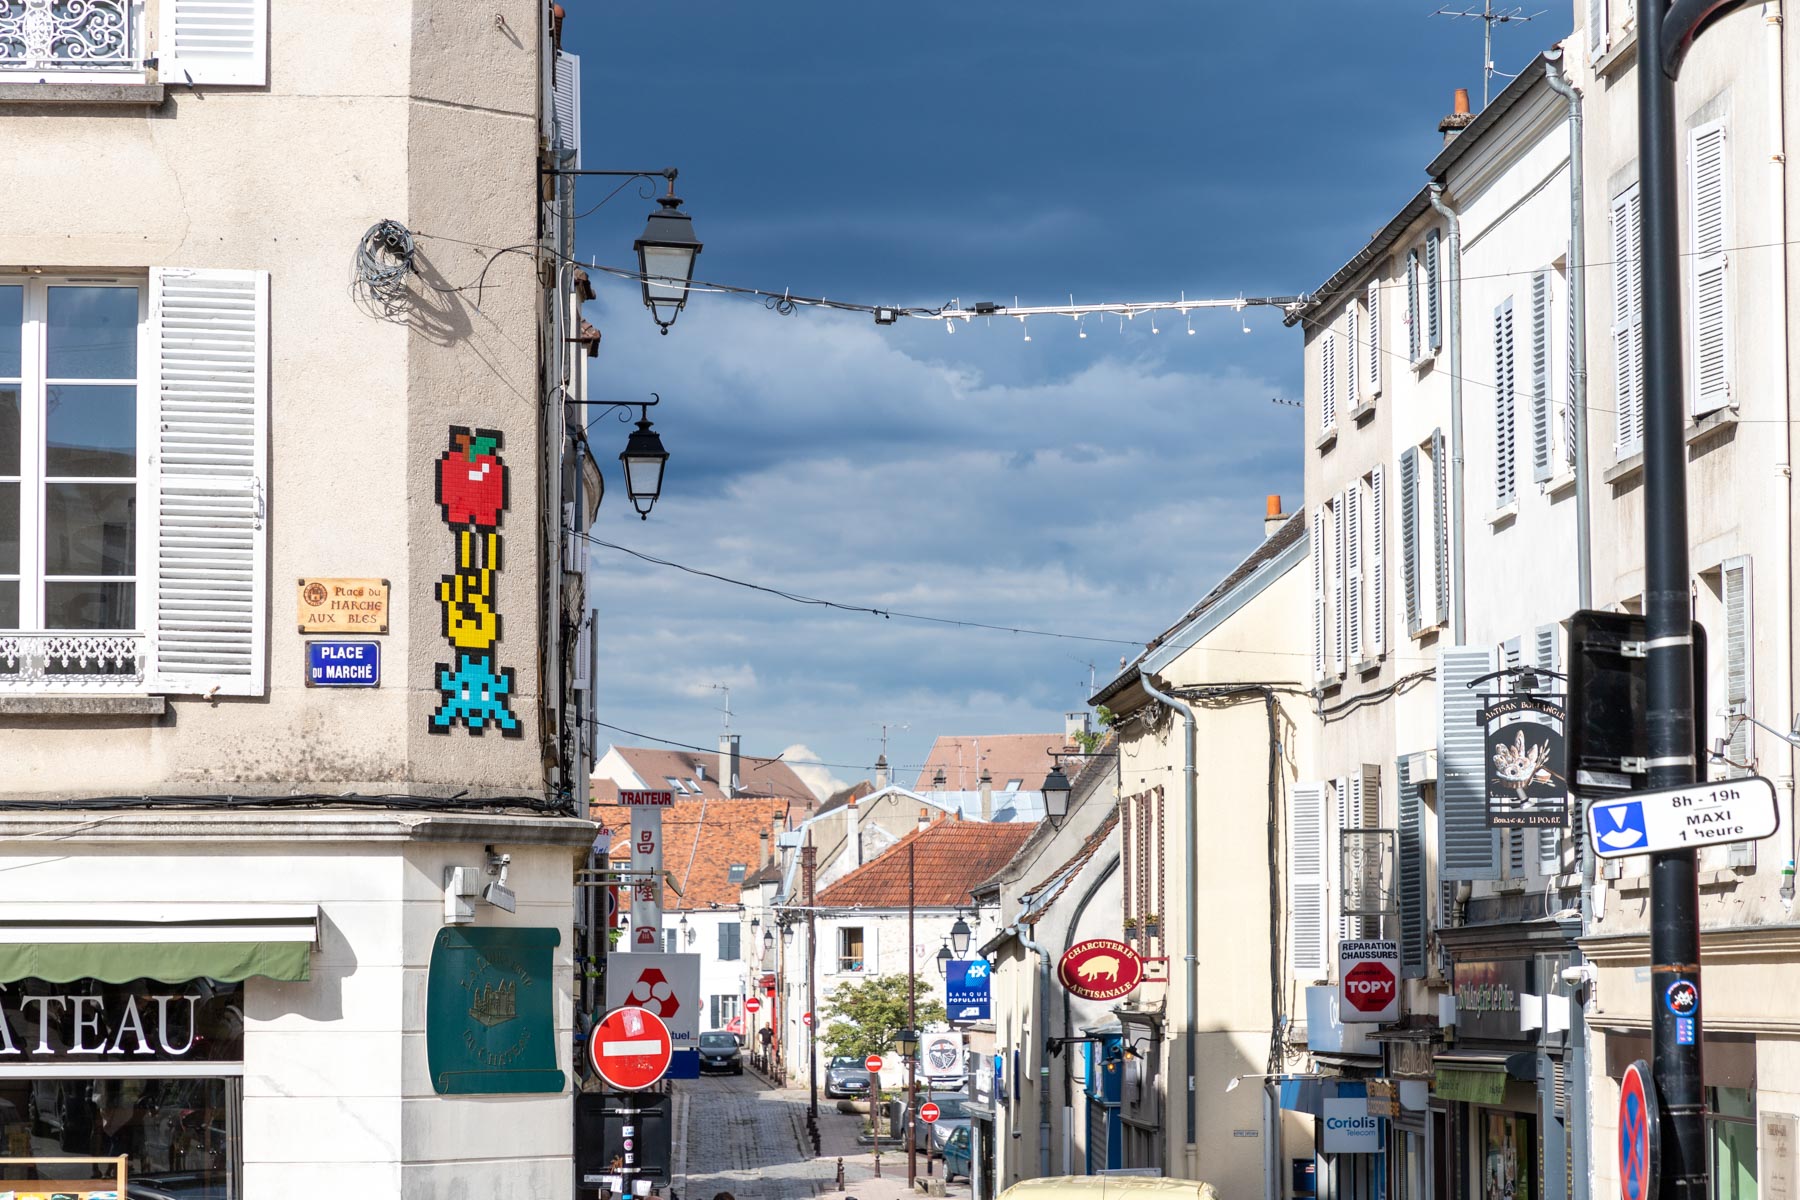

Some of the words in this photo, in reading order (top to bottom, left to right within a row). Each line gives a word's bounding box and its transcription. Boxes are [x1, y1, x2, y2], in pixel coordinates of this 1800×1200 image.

[335, 586, 364, 597] Place
[368, 588, 381, 597] du
[330, 600, 383, 611] MARCHE
[308, 613, 336, 623] AUX
[348, 614, 377, 623] BLES
[321, 646, 364, 659] PLACE
[312, 667, 322, 678] DU
[326, 664, 373, 679] MARCHÉ
[620, 791, 672, 805] TRAITEUR
[1672, 795, 1692, 808] 8h
[1709, 789, 1741, 803] 19h
[1686, 810, 1732, 826] MAXI
[1679, 831, 1688, 842] 1
[1694, 825, 1744, 838] heure
[1068, 941, 1134, 960] CHARCUTERIE
[1342, 942, 1397, 951] REPARATION
[1341, 951, 1398, 960] CHAUSSURES
[1070, 981, 1133, 999] ARTISANALE
[1347, 980, 1393, 994] TOPY
[1326, 1116, 1376, 1130] Coriolis
[1346, 1129, 1376, 1137] Telecom
